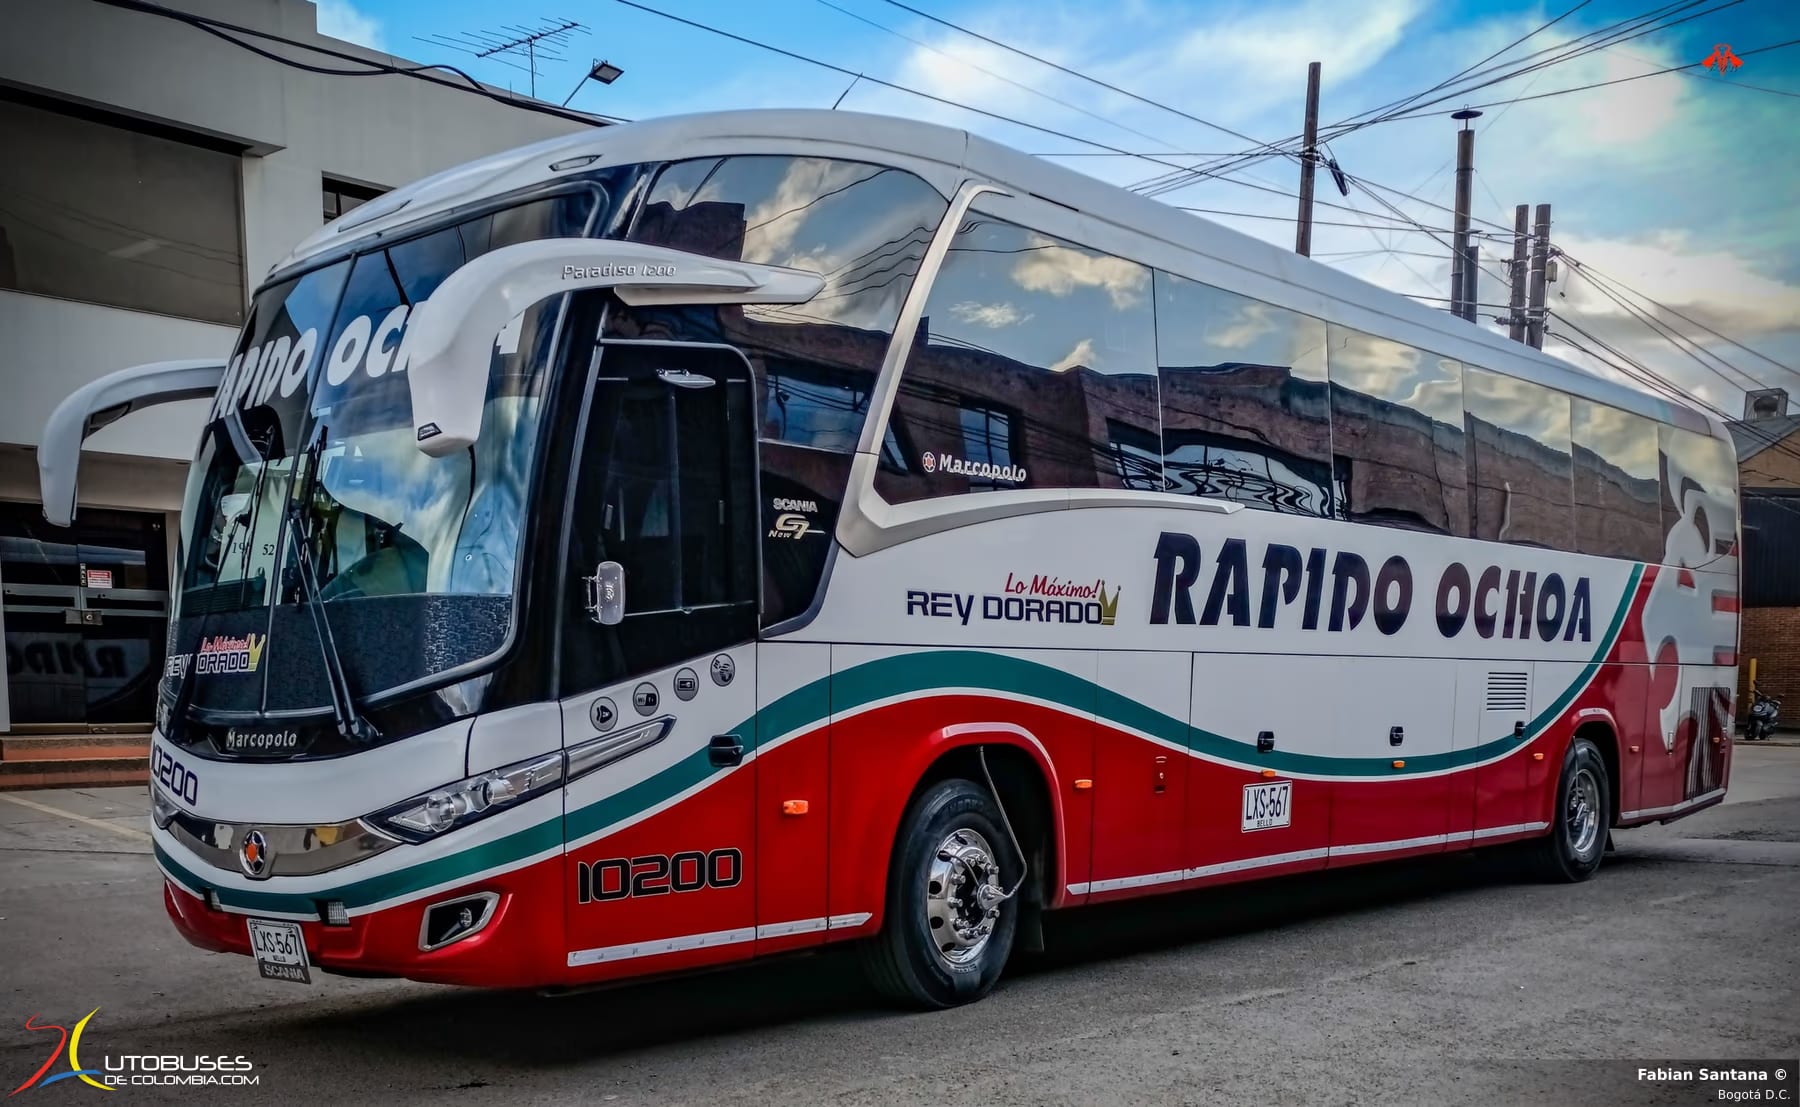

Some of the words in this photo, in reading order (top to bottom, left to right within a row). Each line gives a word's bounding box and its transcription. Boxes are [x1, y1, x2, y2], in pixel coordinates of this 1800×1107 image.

[561, 262, 636, 280] Paradiso
[209, 327, 318, 424] APIDO
[939, 453, 1027, 482] Marcopolo
[773, 497, 818, 513] SCANIA
[1004, 572, 1027, 595] Lo
[1029, 574, 1100, 599] Máximo!
[1149, 531, 1413, 636] RAPIDO
[1435, 561, 1592, 643] OCHOA
[907, 590, 974, 626] REY
[983, 595, 1103, 625] DORADO
[226, 730, 298, 749] Marcopolo
[577, 847, 743, 905] 10200
